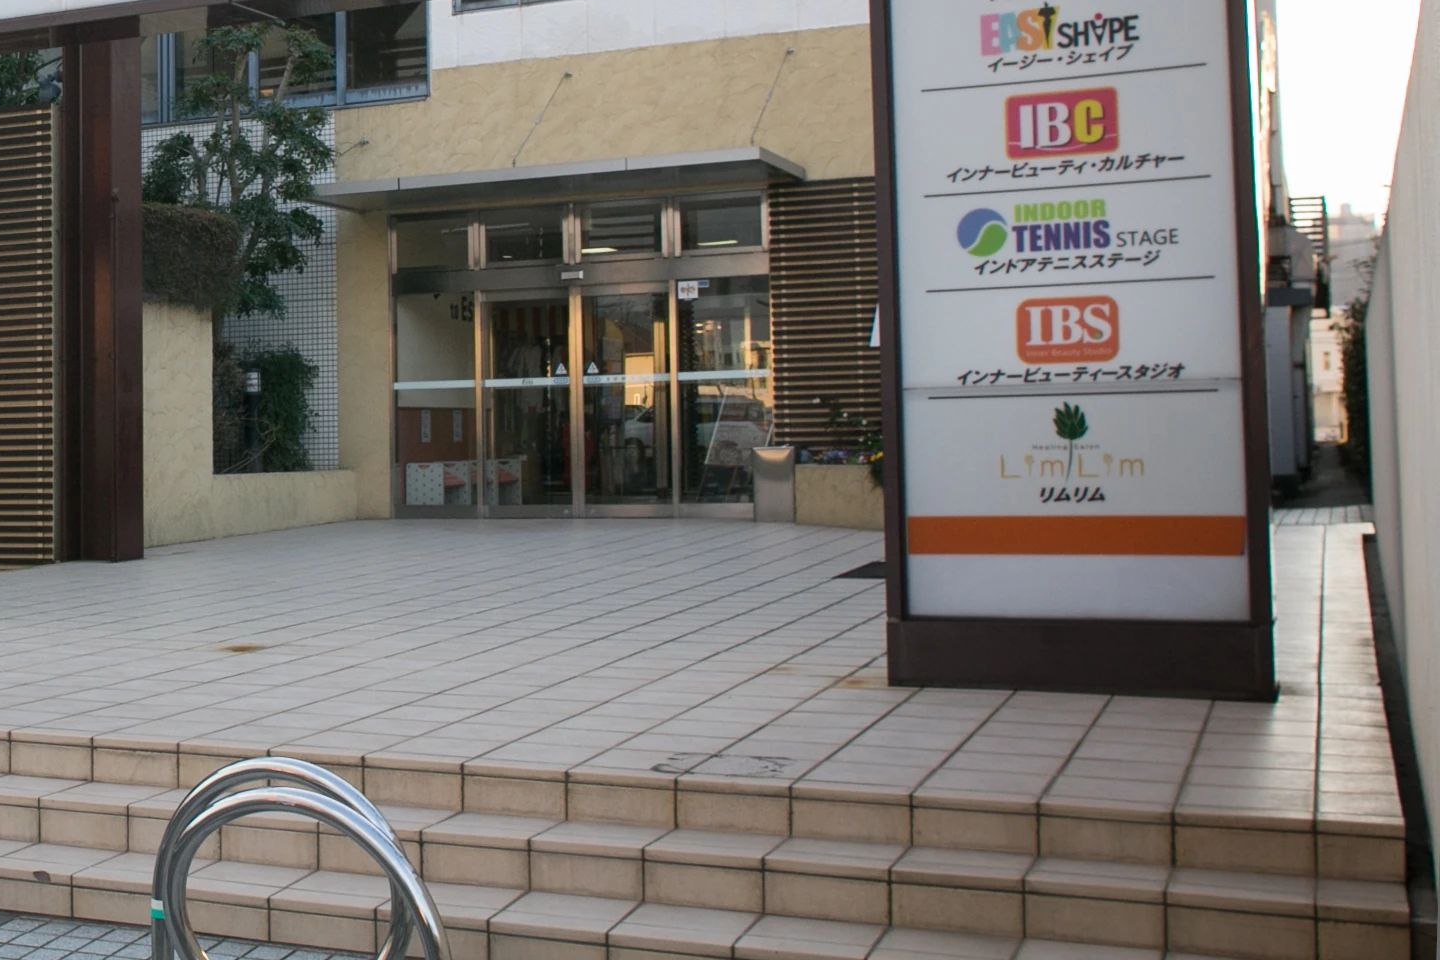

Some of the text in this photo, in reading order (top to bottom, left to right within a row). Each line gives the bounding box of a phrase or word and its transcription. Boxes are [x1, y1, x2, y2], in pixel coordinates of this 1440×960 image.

[1057, 14, 1139, 49] SHAPE
[1018, 99, 1105, 150] IBC
[1014, 199, 1106, 223] INDOOR
[1012, 220, 1180, 253] TENNIS STAGE
[1025, 303, 1113, 346] IBS
[957, 362, 1185, 385] インナービューティースタジオ
[1040, 486, 1106, 504] リムリム
